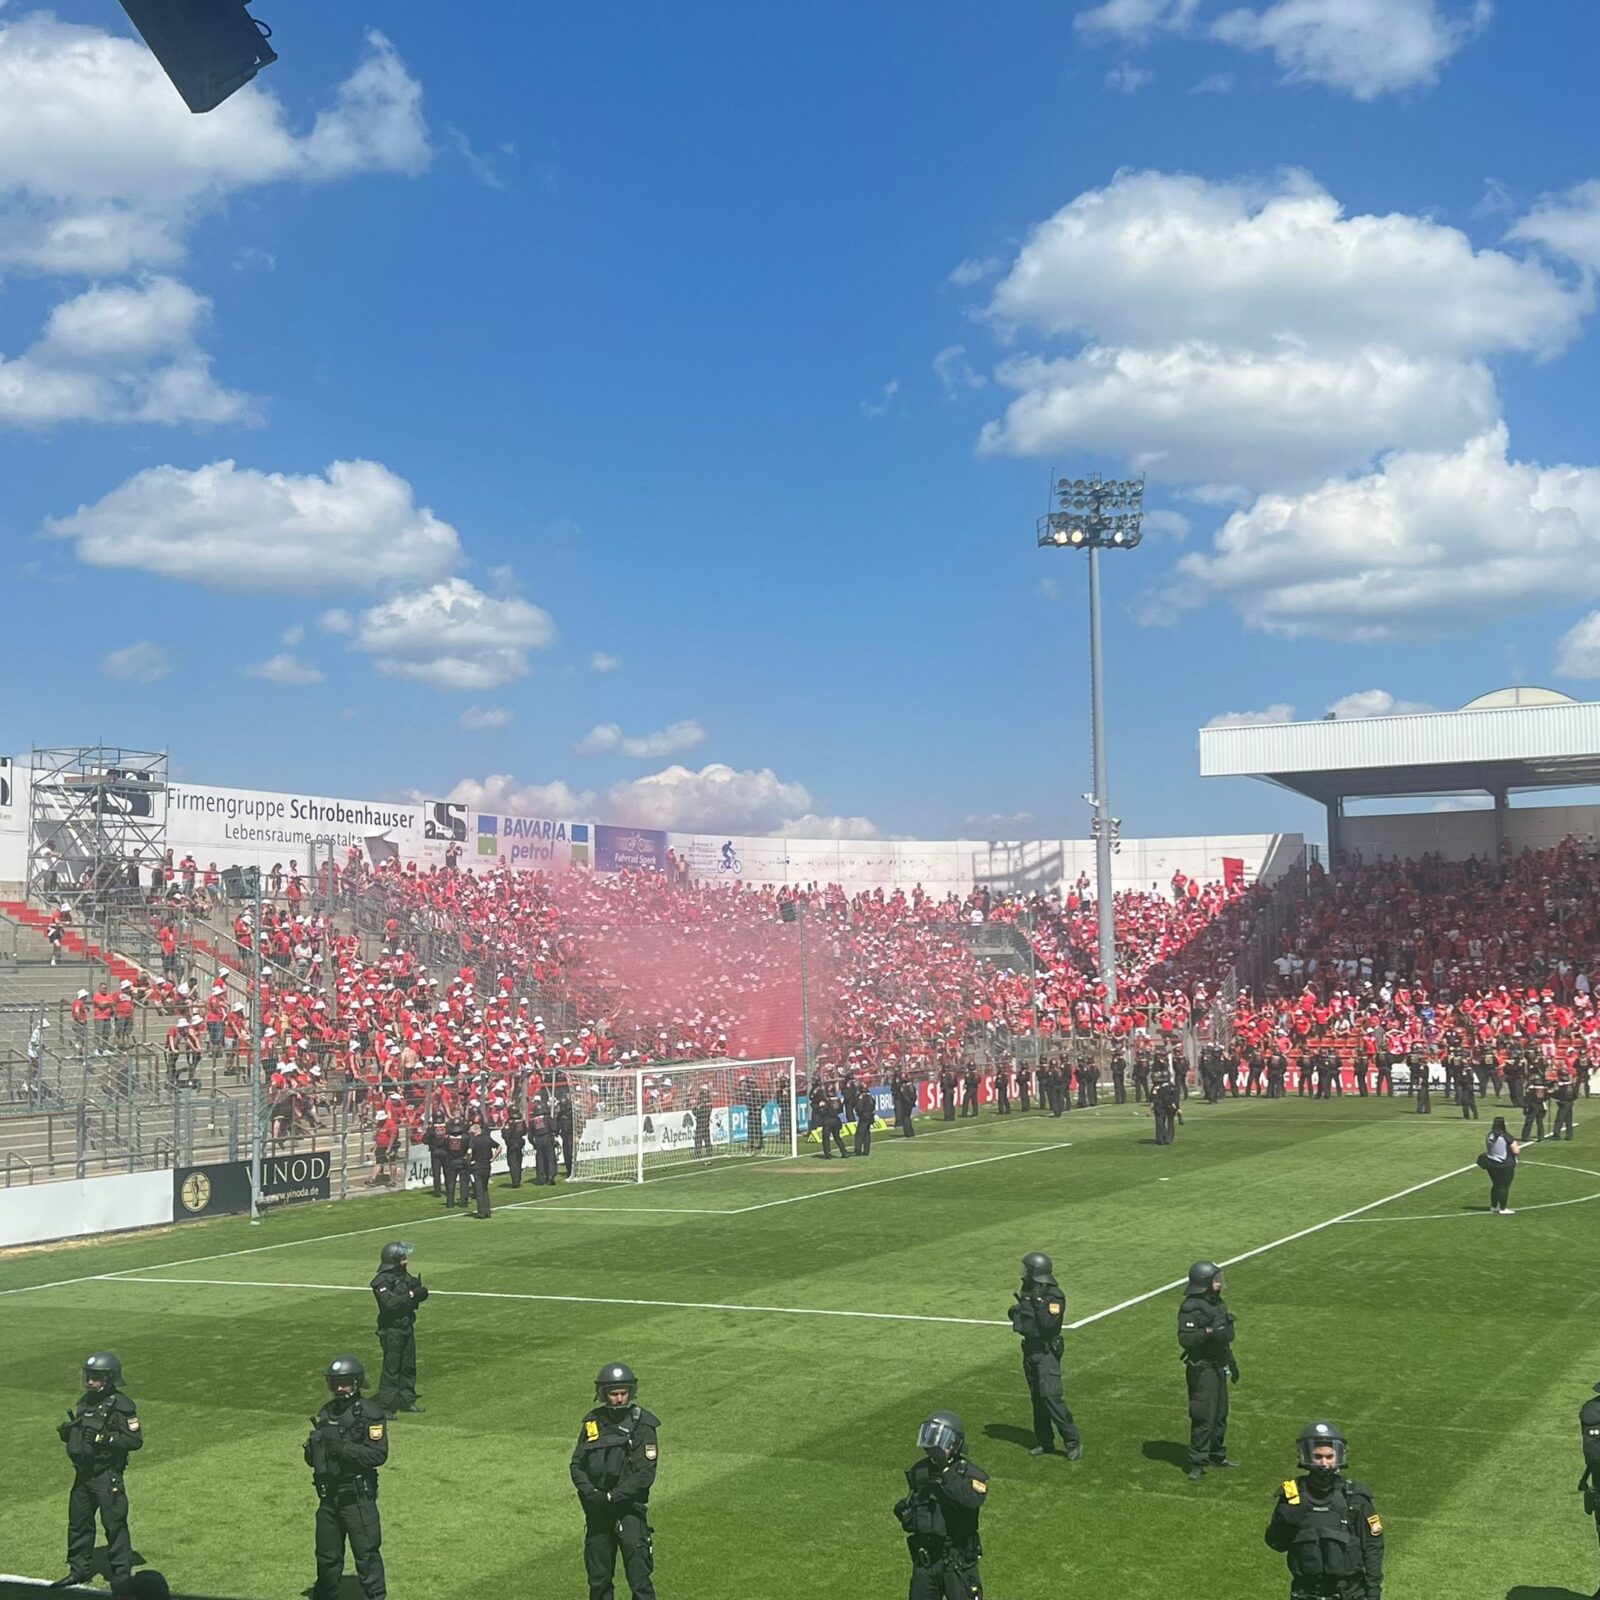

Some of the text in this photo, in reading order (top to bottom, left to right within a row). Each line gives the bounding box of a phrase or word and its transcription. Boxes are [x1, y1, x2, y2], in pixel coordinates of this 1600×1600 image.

[167, 787, 285, 821] Firmengruppe
[290, 798, 414, 828] Schrobenhauser
[225, 823, 363, 849] Lebensräume gestalte
[503, 816, 566, 841] BAVARIA
[510, 841, 555, 863] petrol
[662, 1126, 697, 1147] Alpenba
